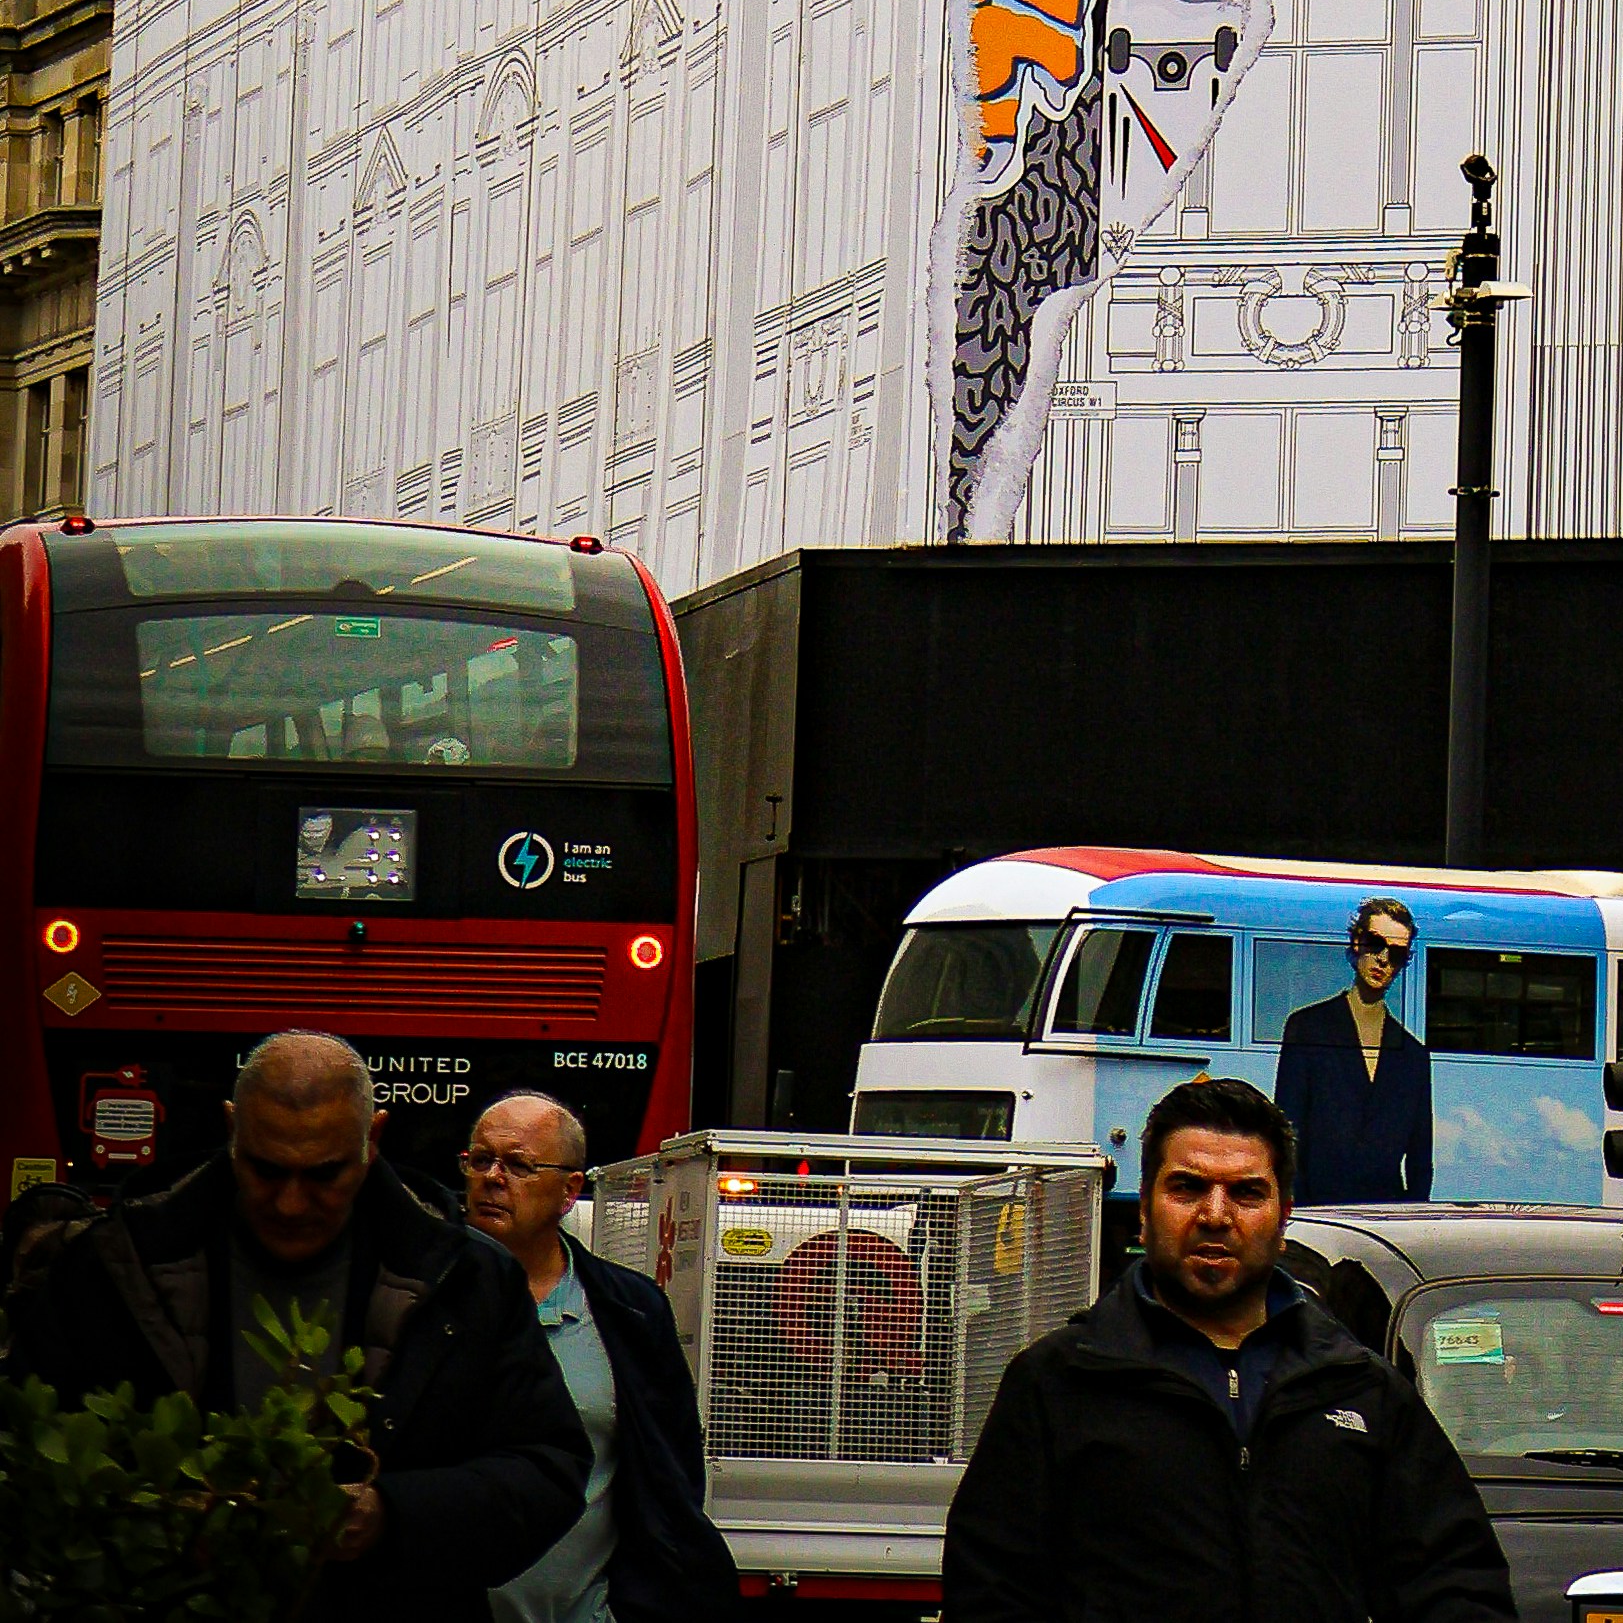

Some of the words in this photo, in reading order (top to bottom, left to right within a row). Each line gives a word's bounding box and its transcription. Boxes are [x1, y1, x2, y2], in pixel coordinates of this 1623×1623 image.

[1051, 397, 1085, 407] CIRCUS
[572, 844, 591, 854] am
[594, 845, 611, 855] an
[564, 857, 612, 869] electric
[563, 871, 587, 883] bus
[368, 1056, 470, 1074] UNITED
[555, 1053, 588, 1069] BCE
[592, 1053, 648, 1070] 47018
[372, 1082, 470, 1104] GROUP
